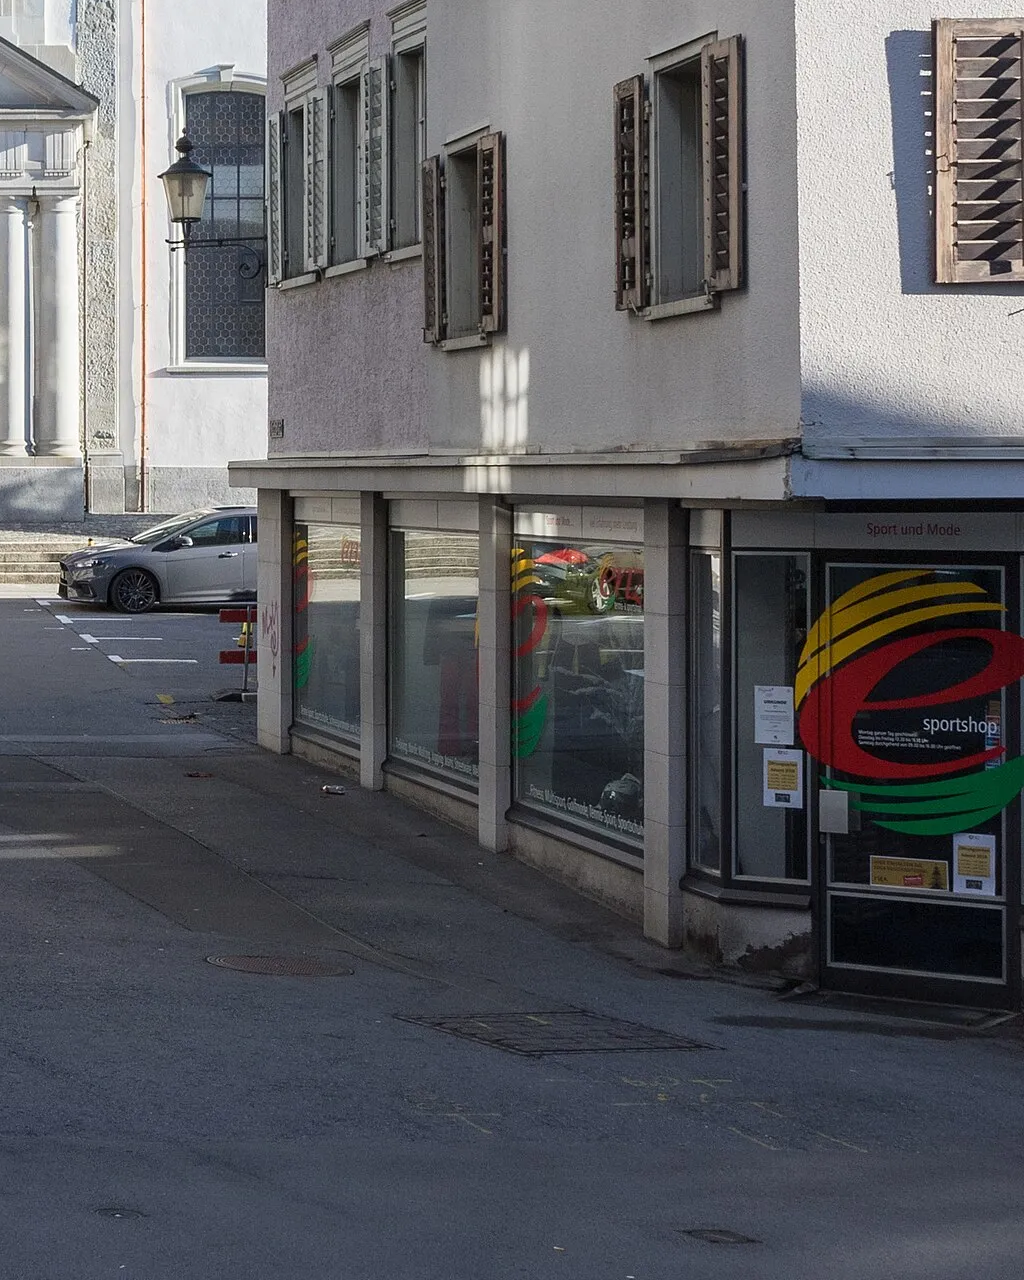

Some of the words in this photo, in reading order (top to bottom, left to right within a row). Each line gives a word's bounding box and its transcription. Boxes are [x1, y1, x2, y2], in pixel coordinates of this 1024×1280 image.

[867, 522, 897, 537] Sport
[901, 523, 923, 536] und
[928, 523, 961, 536] Mode
[923, 716, 998, 737] sportshop
